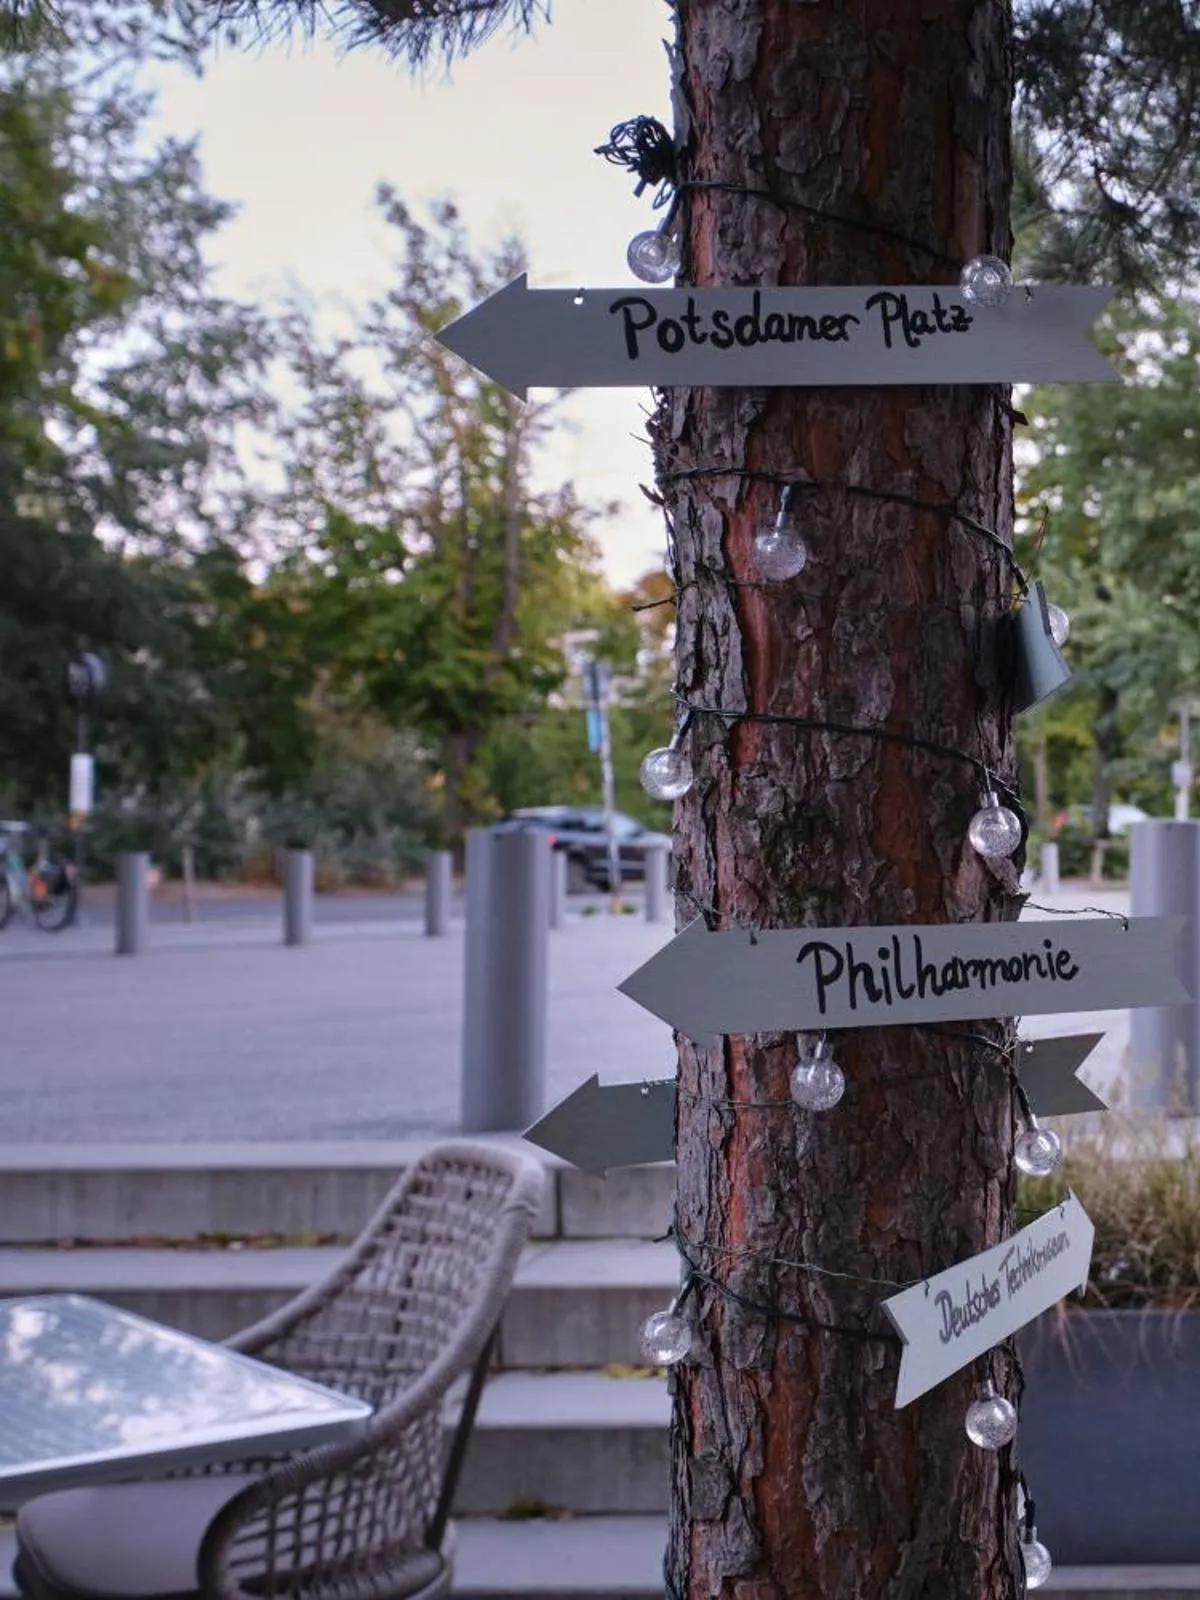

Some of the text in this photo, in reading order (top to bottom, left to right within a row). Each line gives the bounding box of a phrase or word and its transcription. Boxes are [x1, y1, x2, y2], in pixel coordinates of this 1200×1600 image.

[609, 289, 974, 360] Potsdamer Platz
[796, 934, 1081, 1014] Philharmonie
[934, 1272, 1000, 1344] Deutsches
